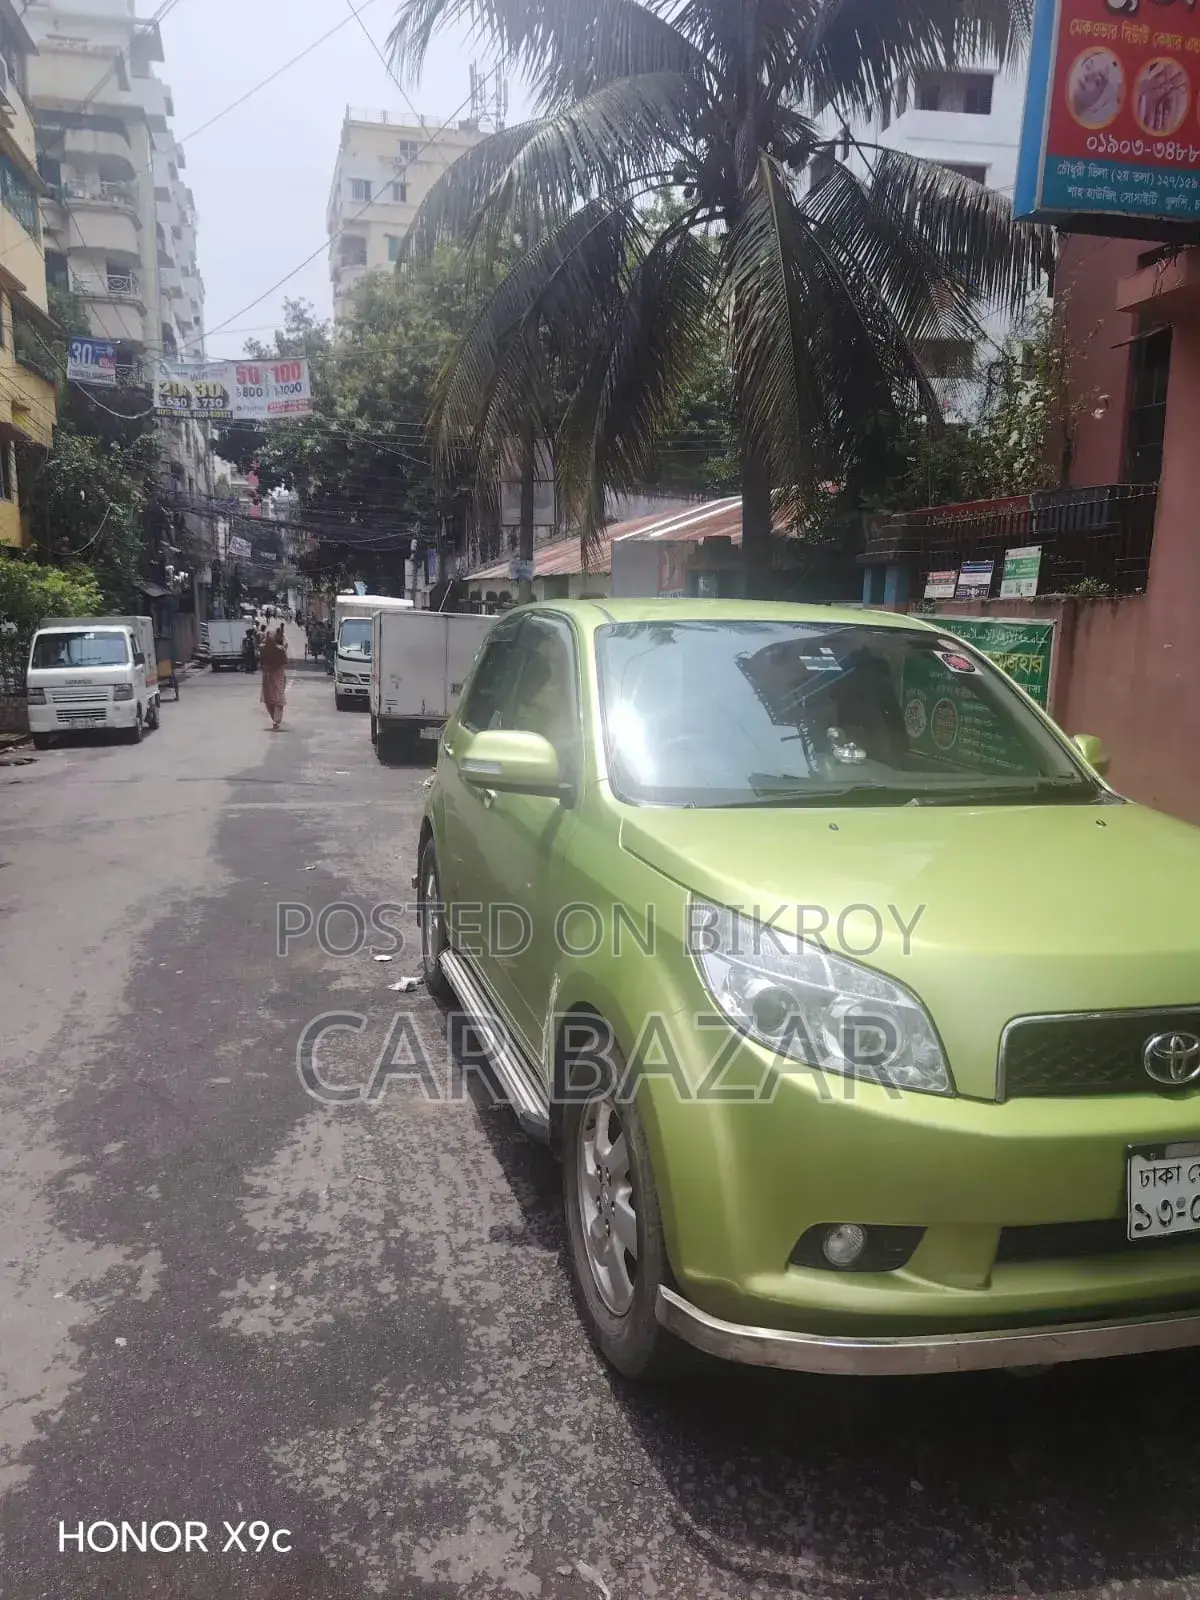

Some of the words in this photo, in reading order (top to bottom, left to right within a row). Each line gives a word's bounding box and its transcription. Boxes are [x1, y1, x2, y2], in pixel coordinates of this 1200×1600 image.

[1121, 20, 1150, 44] বিউটি
[1057, 160, 1086, 179] চৌধুরী
[1088, 162, 1109, 179] ভিলা
[71, 341, 93, 368] 30
[235, 364, 262, 385] 50
[269, 361, 302, 384] 100
[194, 382, 223, 398] 30
[1139, 1165, 1182, 1188] ঢাকা
